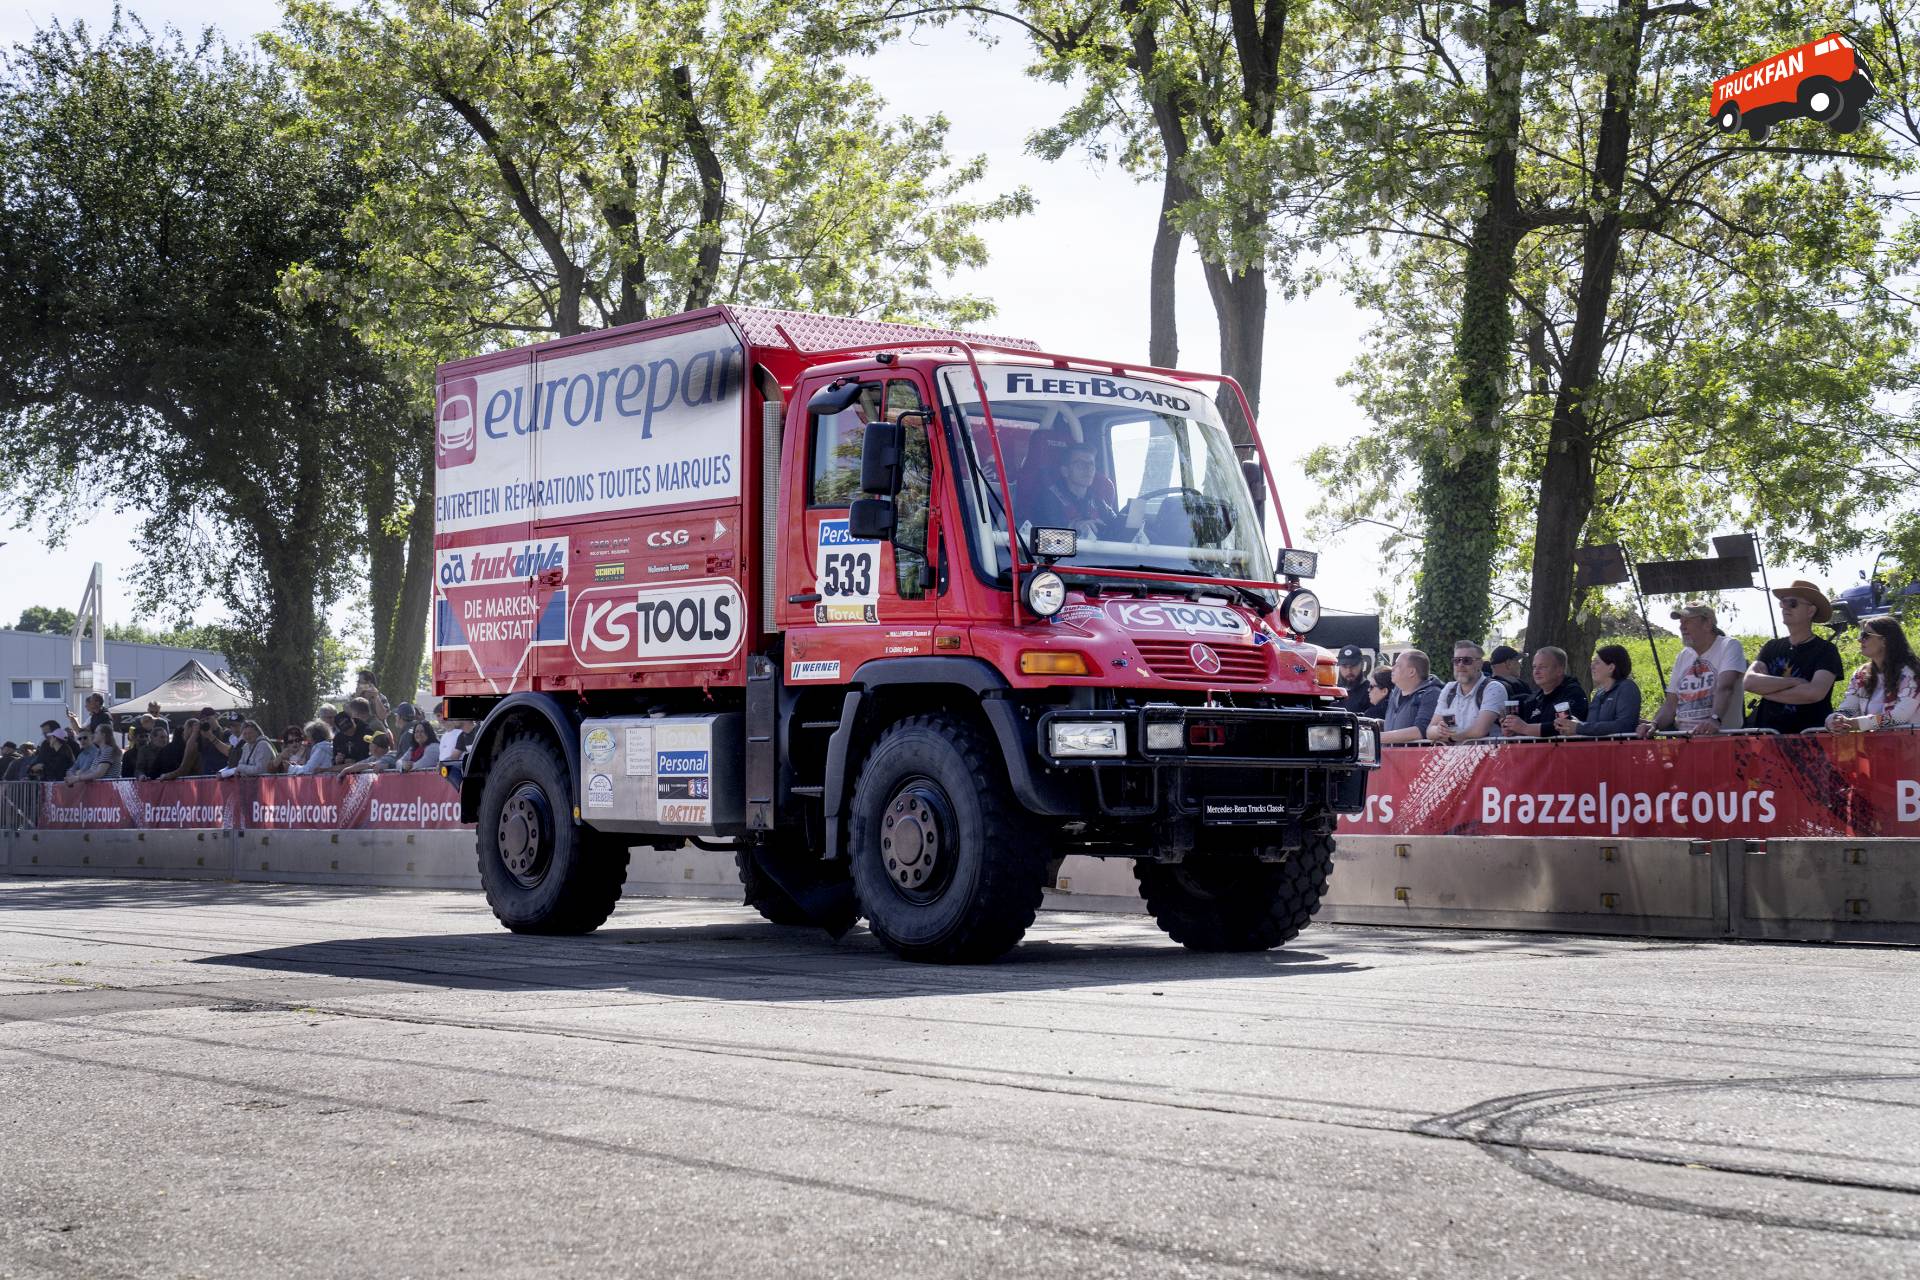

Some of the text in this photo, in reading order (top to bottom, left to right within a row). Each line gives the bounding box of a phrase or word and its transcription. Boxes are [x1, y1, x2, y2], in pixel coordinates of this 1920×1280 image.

[484, 344, 743, 440] eurorepar
[436, 454, 732, 522] ENTRETIEN RÉPARATIONS TOUTES MARQUES
[647, 529, 690, 547] CSG
[821, 526, 870, 543] Pers
[823, 553, 872, 597] 533
[464, 595, 540, 620] DIE MARKEN-
[1118, 604, 1240, 629] KS TOOLS
[467, 619, 534, 644] WERKSTATT
[581, 596, 732, 652] KS TOOLS
[802, 662, 839, 672] WERNER
[1679, 674, 1714, 691] Gulf
[659, 753, 707, 771] Personal
[50, 802, 121, 828] Brazzelparcours
[145, 800, 223, 827] Brazzelparcours
[252, 799, 338, 828] Brazzelparcours
[370, 797, 462, 828] Brazzelparco
[661, 805, 707, 822] LOCTITE
[1206, 804, 1285, 814] Mercedes-Benz Trucks Classic
[1481, 782, 1776, 835] Brazzelparcours
